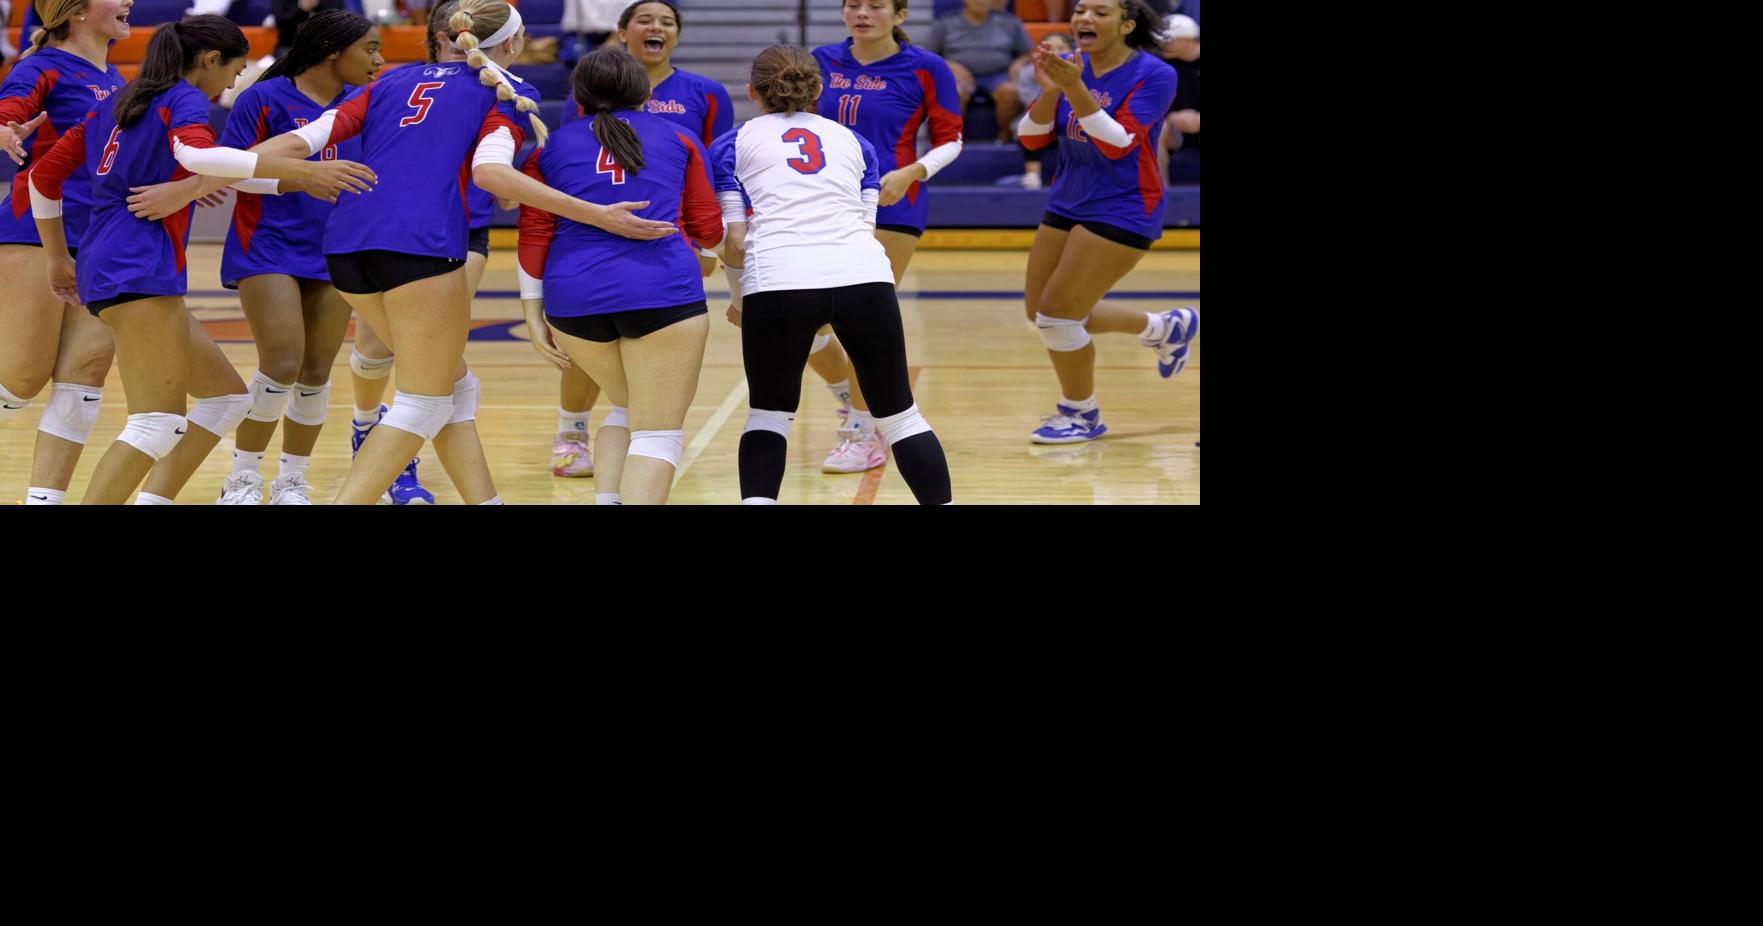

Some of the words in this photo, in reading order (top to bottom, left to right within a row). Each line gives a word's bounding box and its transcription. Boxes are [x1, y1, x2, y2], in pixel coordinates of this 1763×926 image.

[829, 72, 851, 89] The
[854, 74, 887, 91] Side
[400, 81, 446, 127] 5
[647, 99, 686, 114] Side
[838, 94, 862, 126] 11
[96, 123, 123, 176] 6
[596, 144, 626, 185] 4
[781, 127, 827, 175] 3
